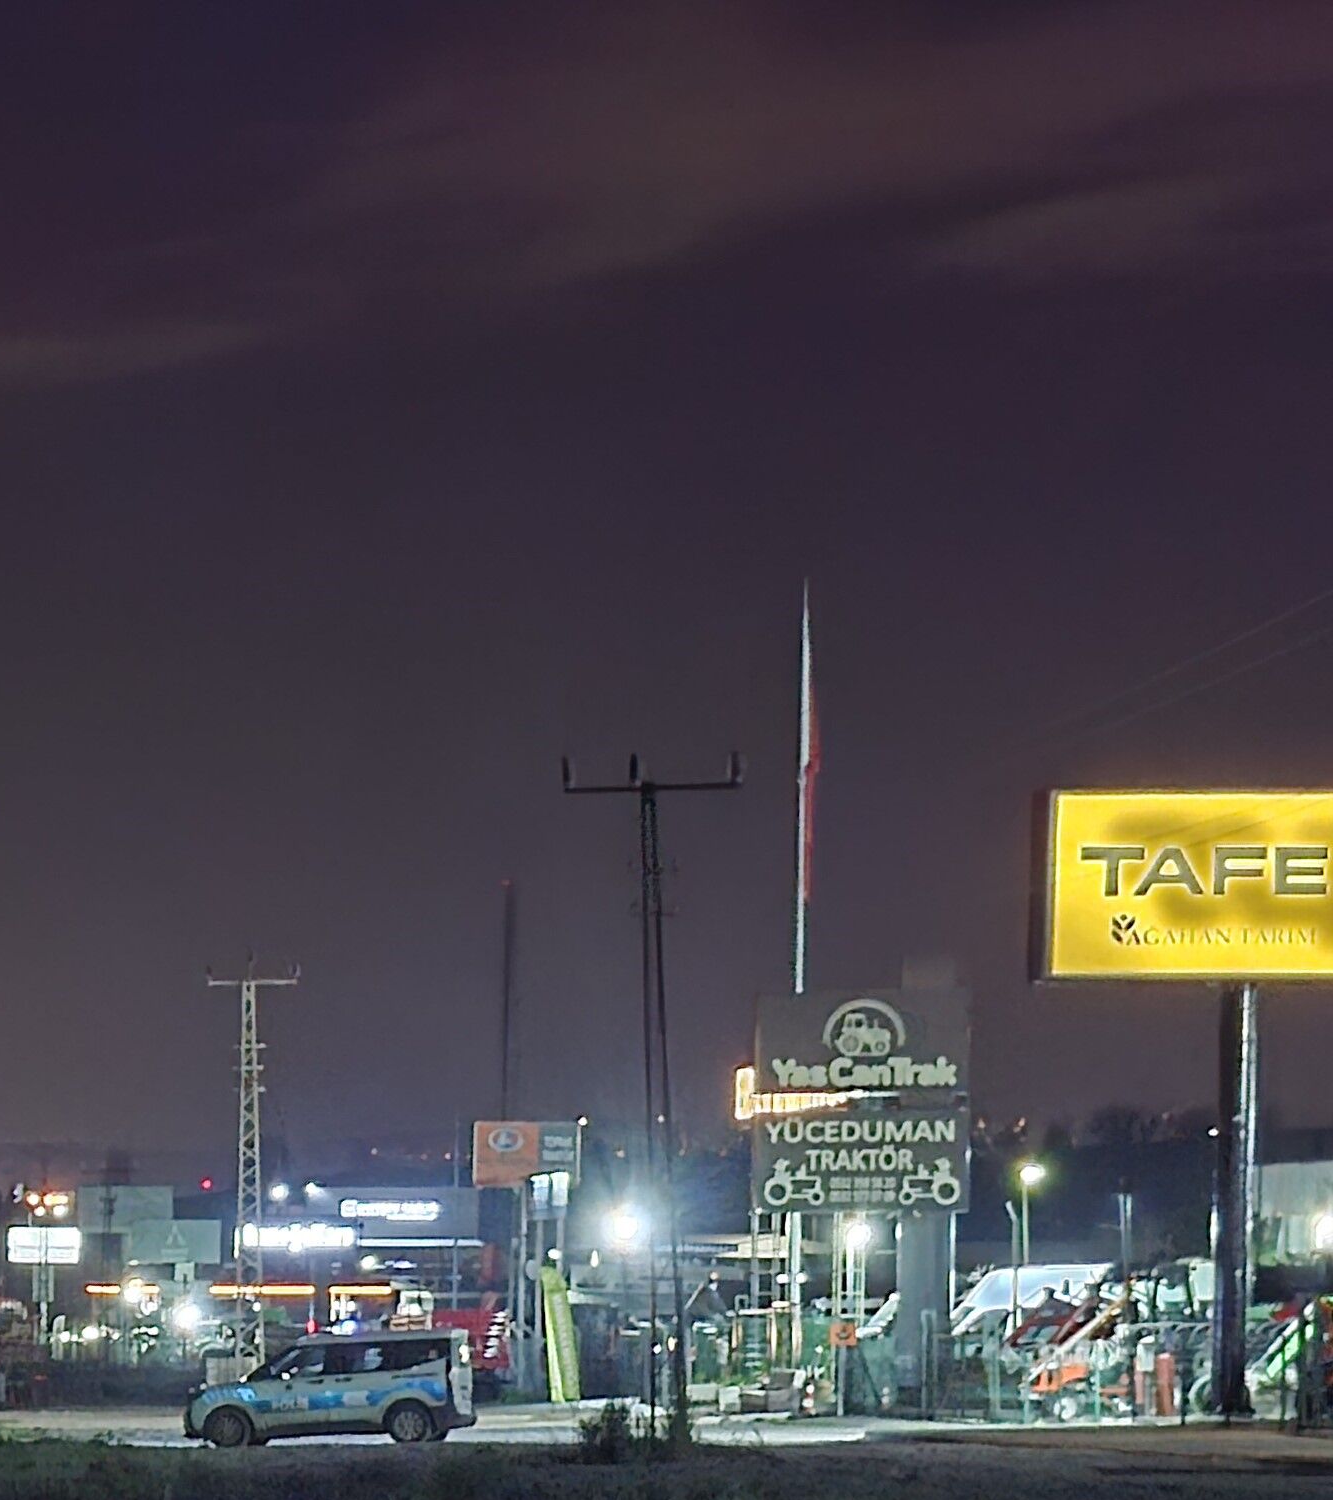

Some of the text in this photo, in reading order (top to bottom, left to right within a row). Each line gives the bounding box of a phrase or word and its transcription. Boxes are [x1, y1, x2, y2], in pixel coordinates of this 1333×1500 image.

[1080, 846, 1328, 896] TAFE
[1241, 926, 1317, 945] TARIM
[765, 1116, 956, 1144] YÜCEDUMAN
[805, 1144, 914, 1172] TRAKTÖR
